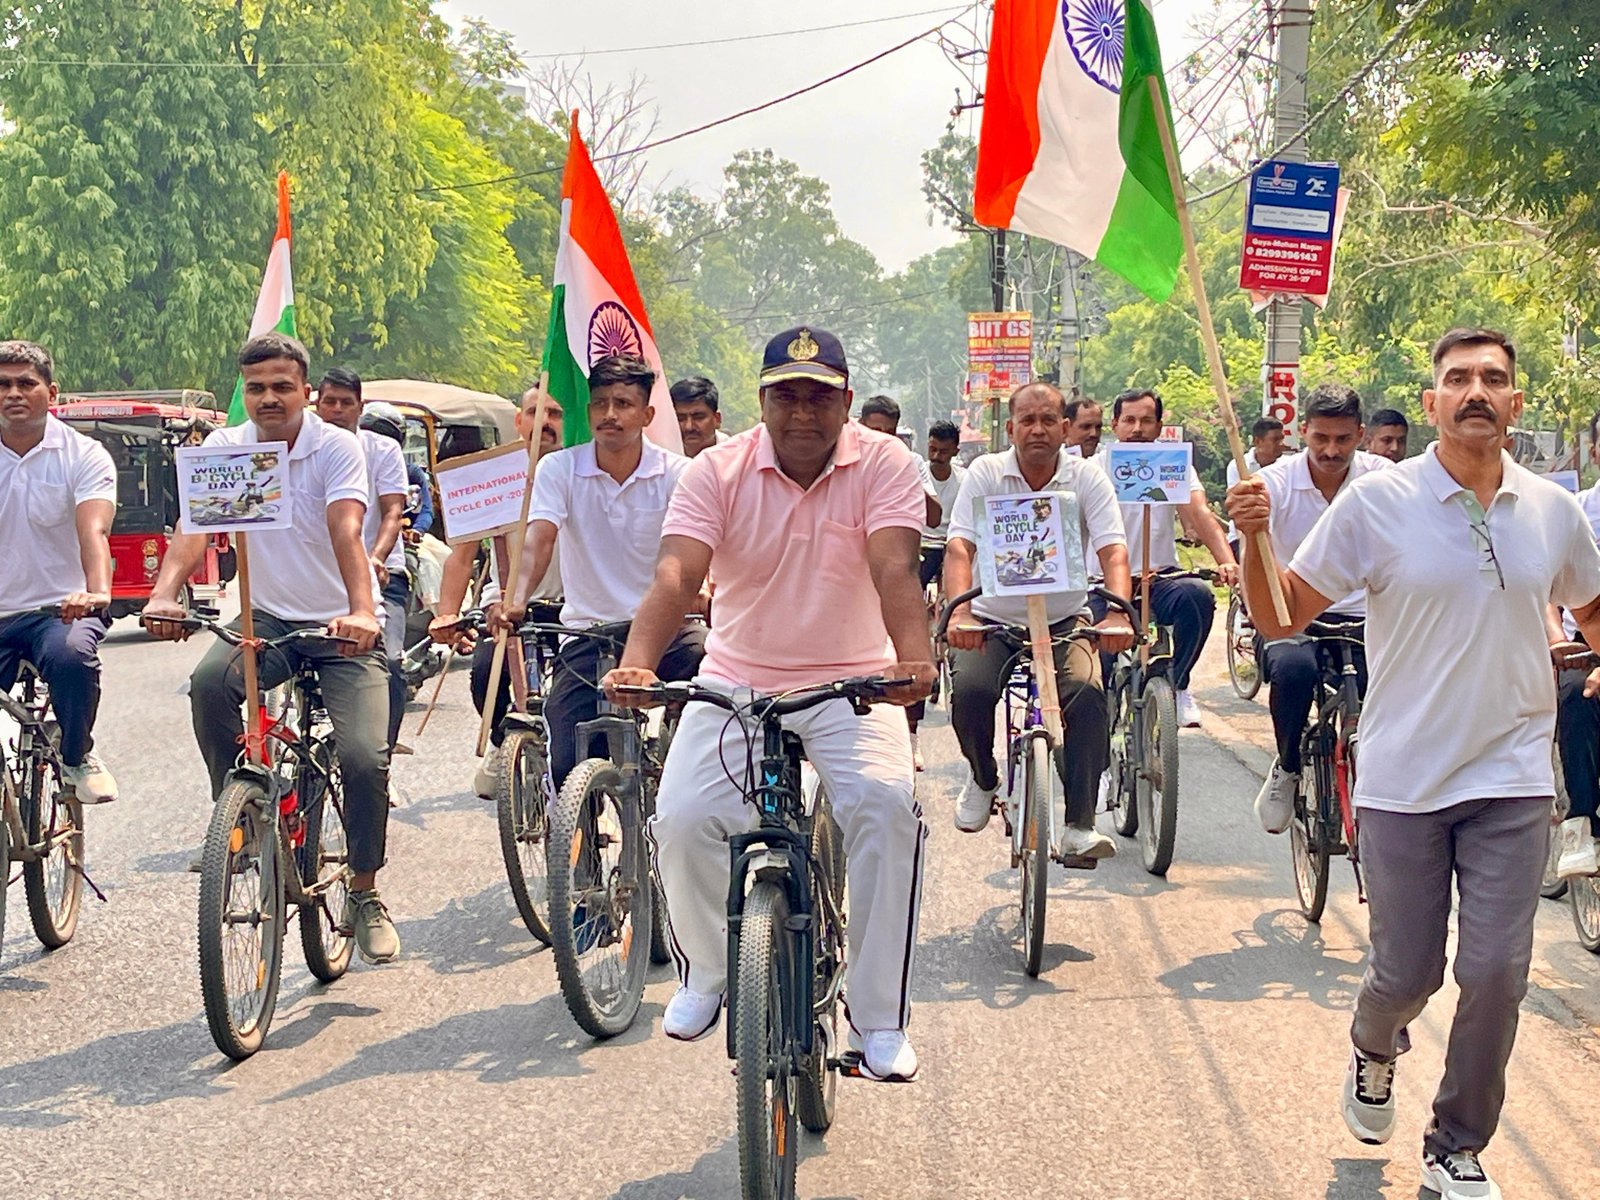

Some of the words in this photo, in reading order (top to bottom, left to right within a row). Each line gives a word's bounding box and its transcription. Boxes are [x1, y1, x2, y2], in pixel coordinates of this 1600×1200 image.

[1255, 248, 1318, 262] 8299396143
[1248, 263, 1298, 274] ADMISSIONS
[1299, 268, 1322, 276] OPEN
[1259, 272, 1276, 280] FOR
[1276, 273, 1288, 281] AY
[968, 321, 1003, 338] BIIT
[1007, 320, 1031, 337] GS
[194, 465, 243, 474] WORLD
[1159, 465, 1186, 473] WORLD
[208, 481, 237, 490] DAY
[447, 471, 528, 500] INTERNATIONAL
[448, 500, 482, 515] CYCLE
[484, 495, 504, 506] DAY
[994, 513, 1029, 524] WORLD
[1005, 533, 1025, 543] DAY
